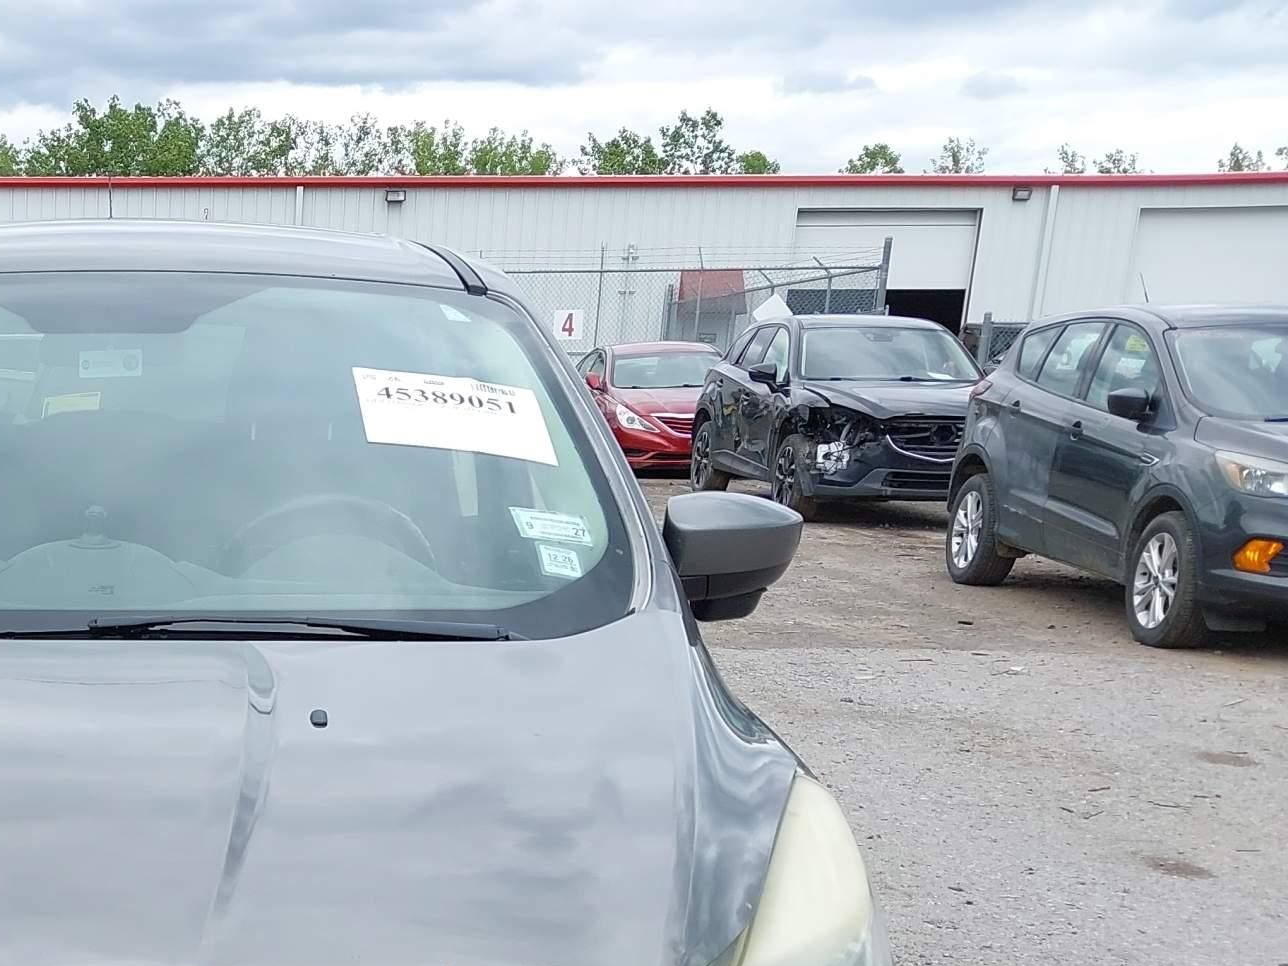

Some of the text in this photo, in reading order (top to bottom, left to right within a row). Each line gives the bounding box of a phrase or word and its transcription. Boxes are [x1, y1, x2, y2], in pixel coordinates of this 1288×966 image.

[561, 312, 575, 337] 4
[376, 386, 517, 415] 45389051
[571, 527, 586, 537] 27
